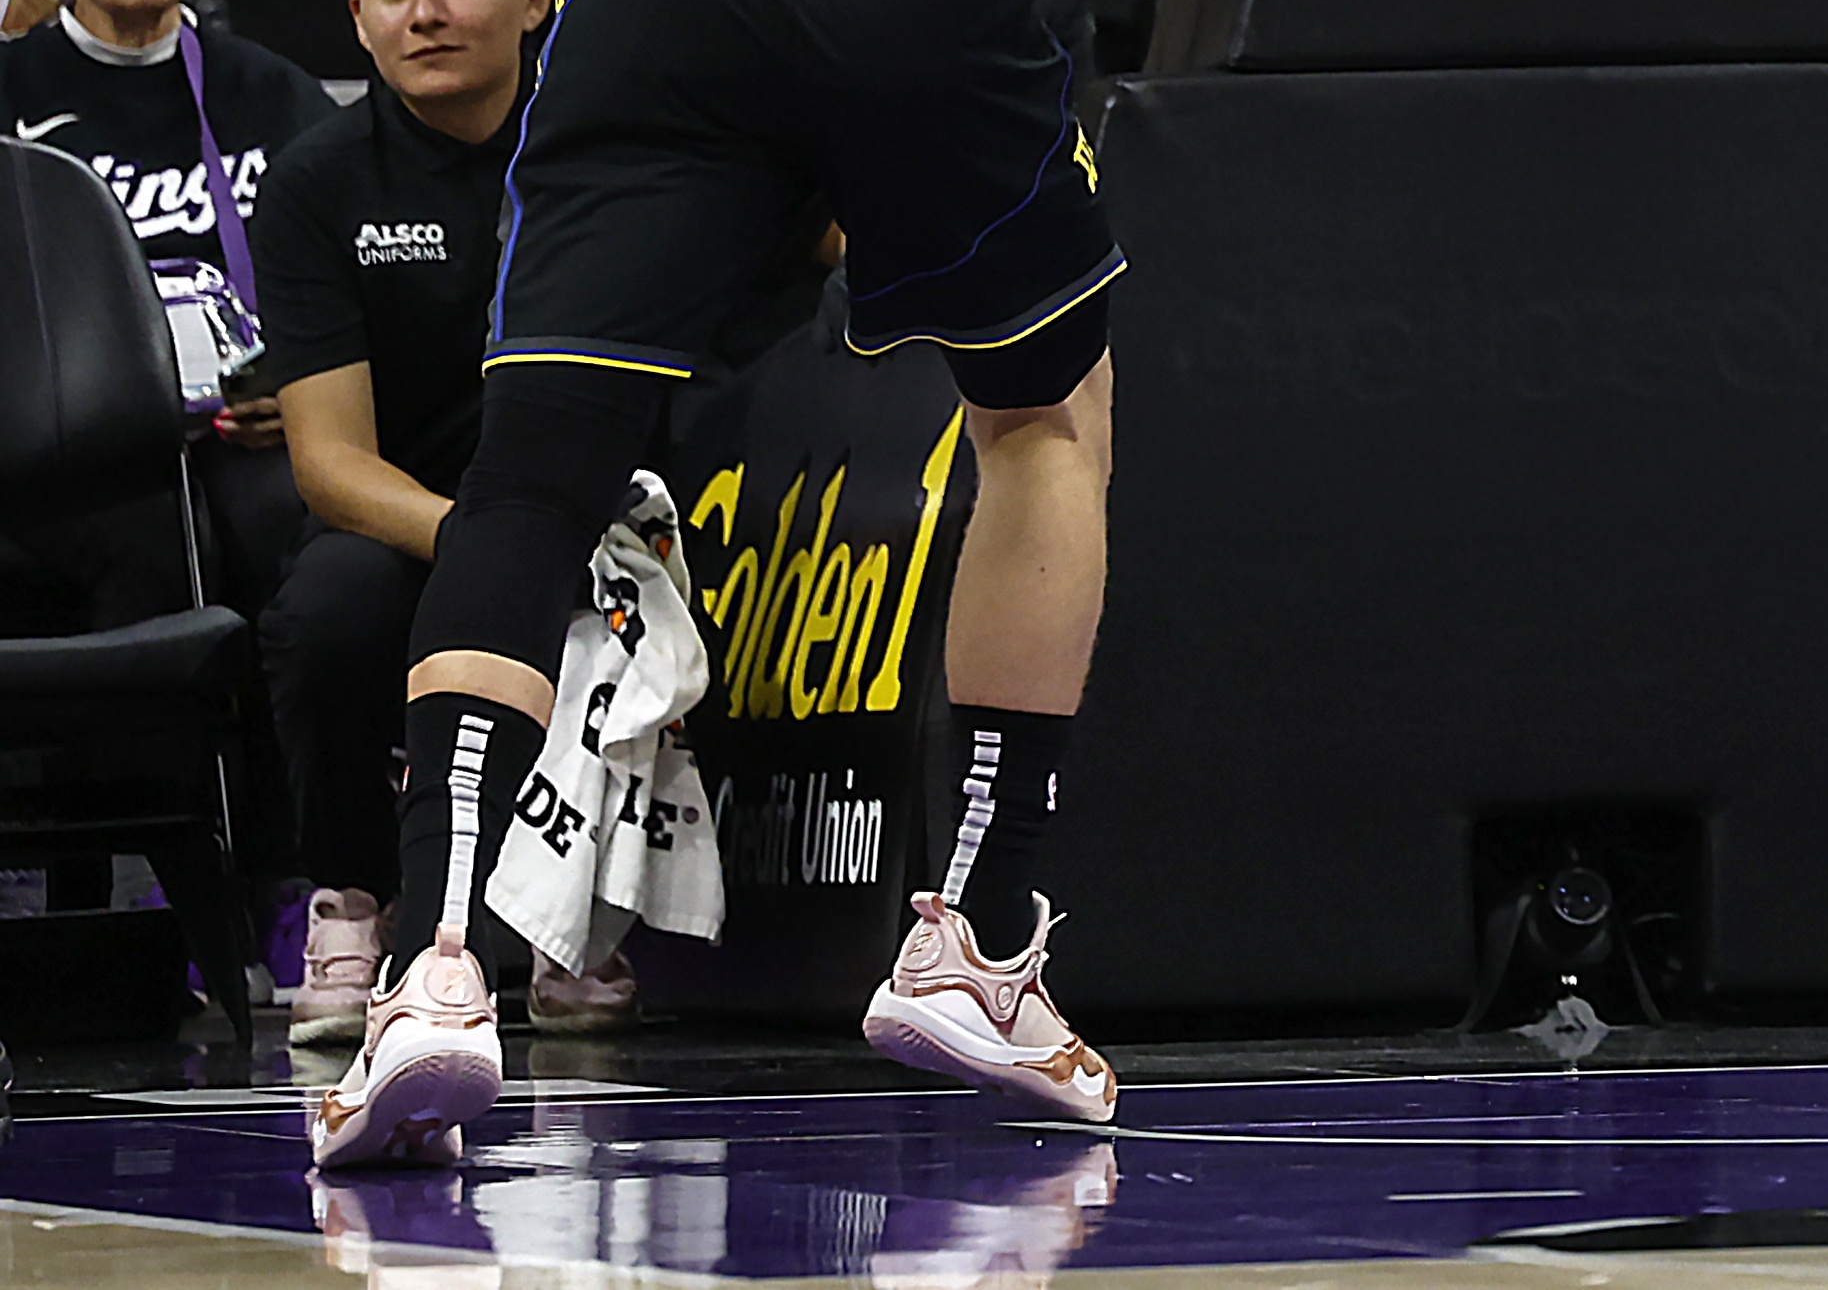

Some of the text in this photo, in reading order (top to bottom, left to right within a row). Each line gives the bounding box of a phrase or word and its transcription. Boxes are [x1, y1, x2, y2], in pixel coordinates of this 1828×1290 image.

[355, 223, 445, 248] ALSCO
[357, 246, 447, 266] UNIFORMS
[802, 767, 883, 885] Union
